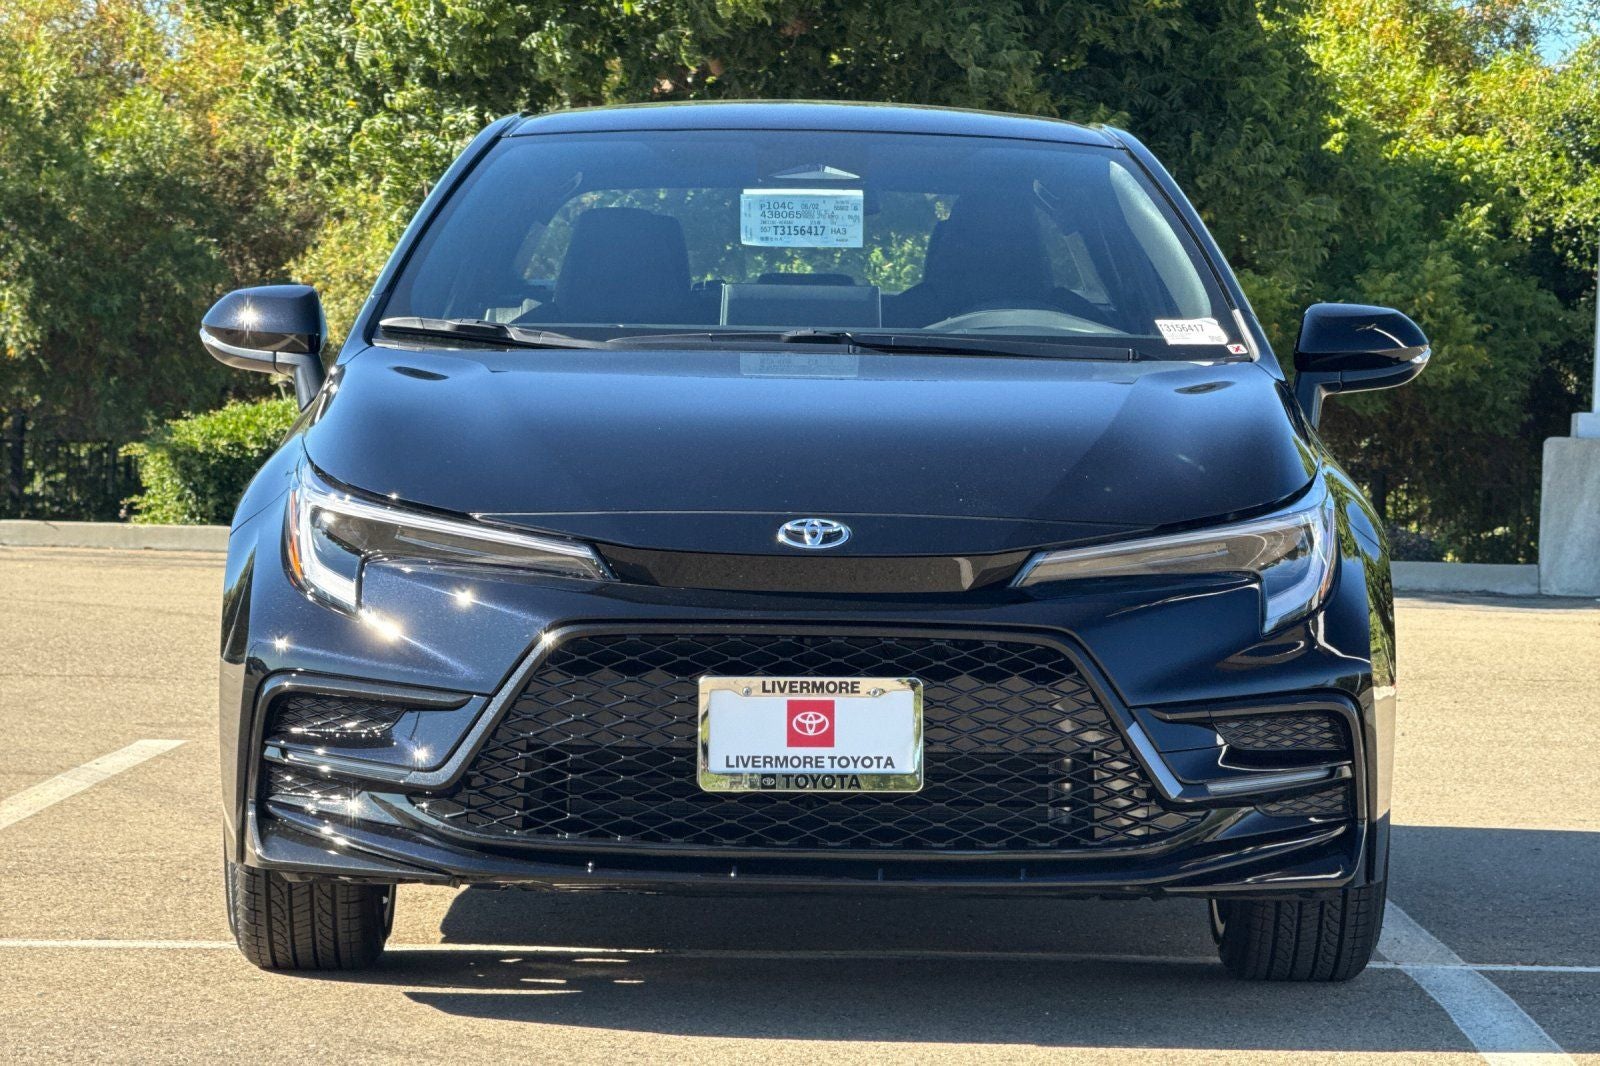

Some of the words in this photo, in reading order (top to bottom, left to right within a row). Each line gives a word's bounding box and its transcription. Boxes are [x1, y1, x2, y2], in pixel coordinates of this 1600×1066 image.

[773, 225, 826, 236] T3156417
[761, 680, 861, 694] LIVERMORE
[725, 755, 825, 769] LIVERMORE
[828, 755, 895, 769] TOYOTA
[781, 774, 861, 789] TOYOTA
